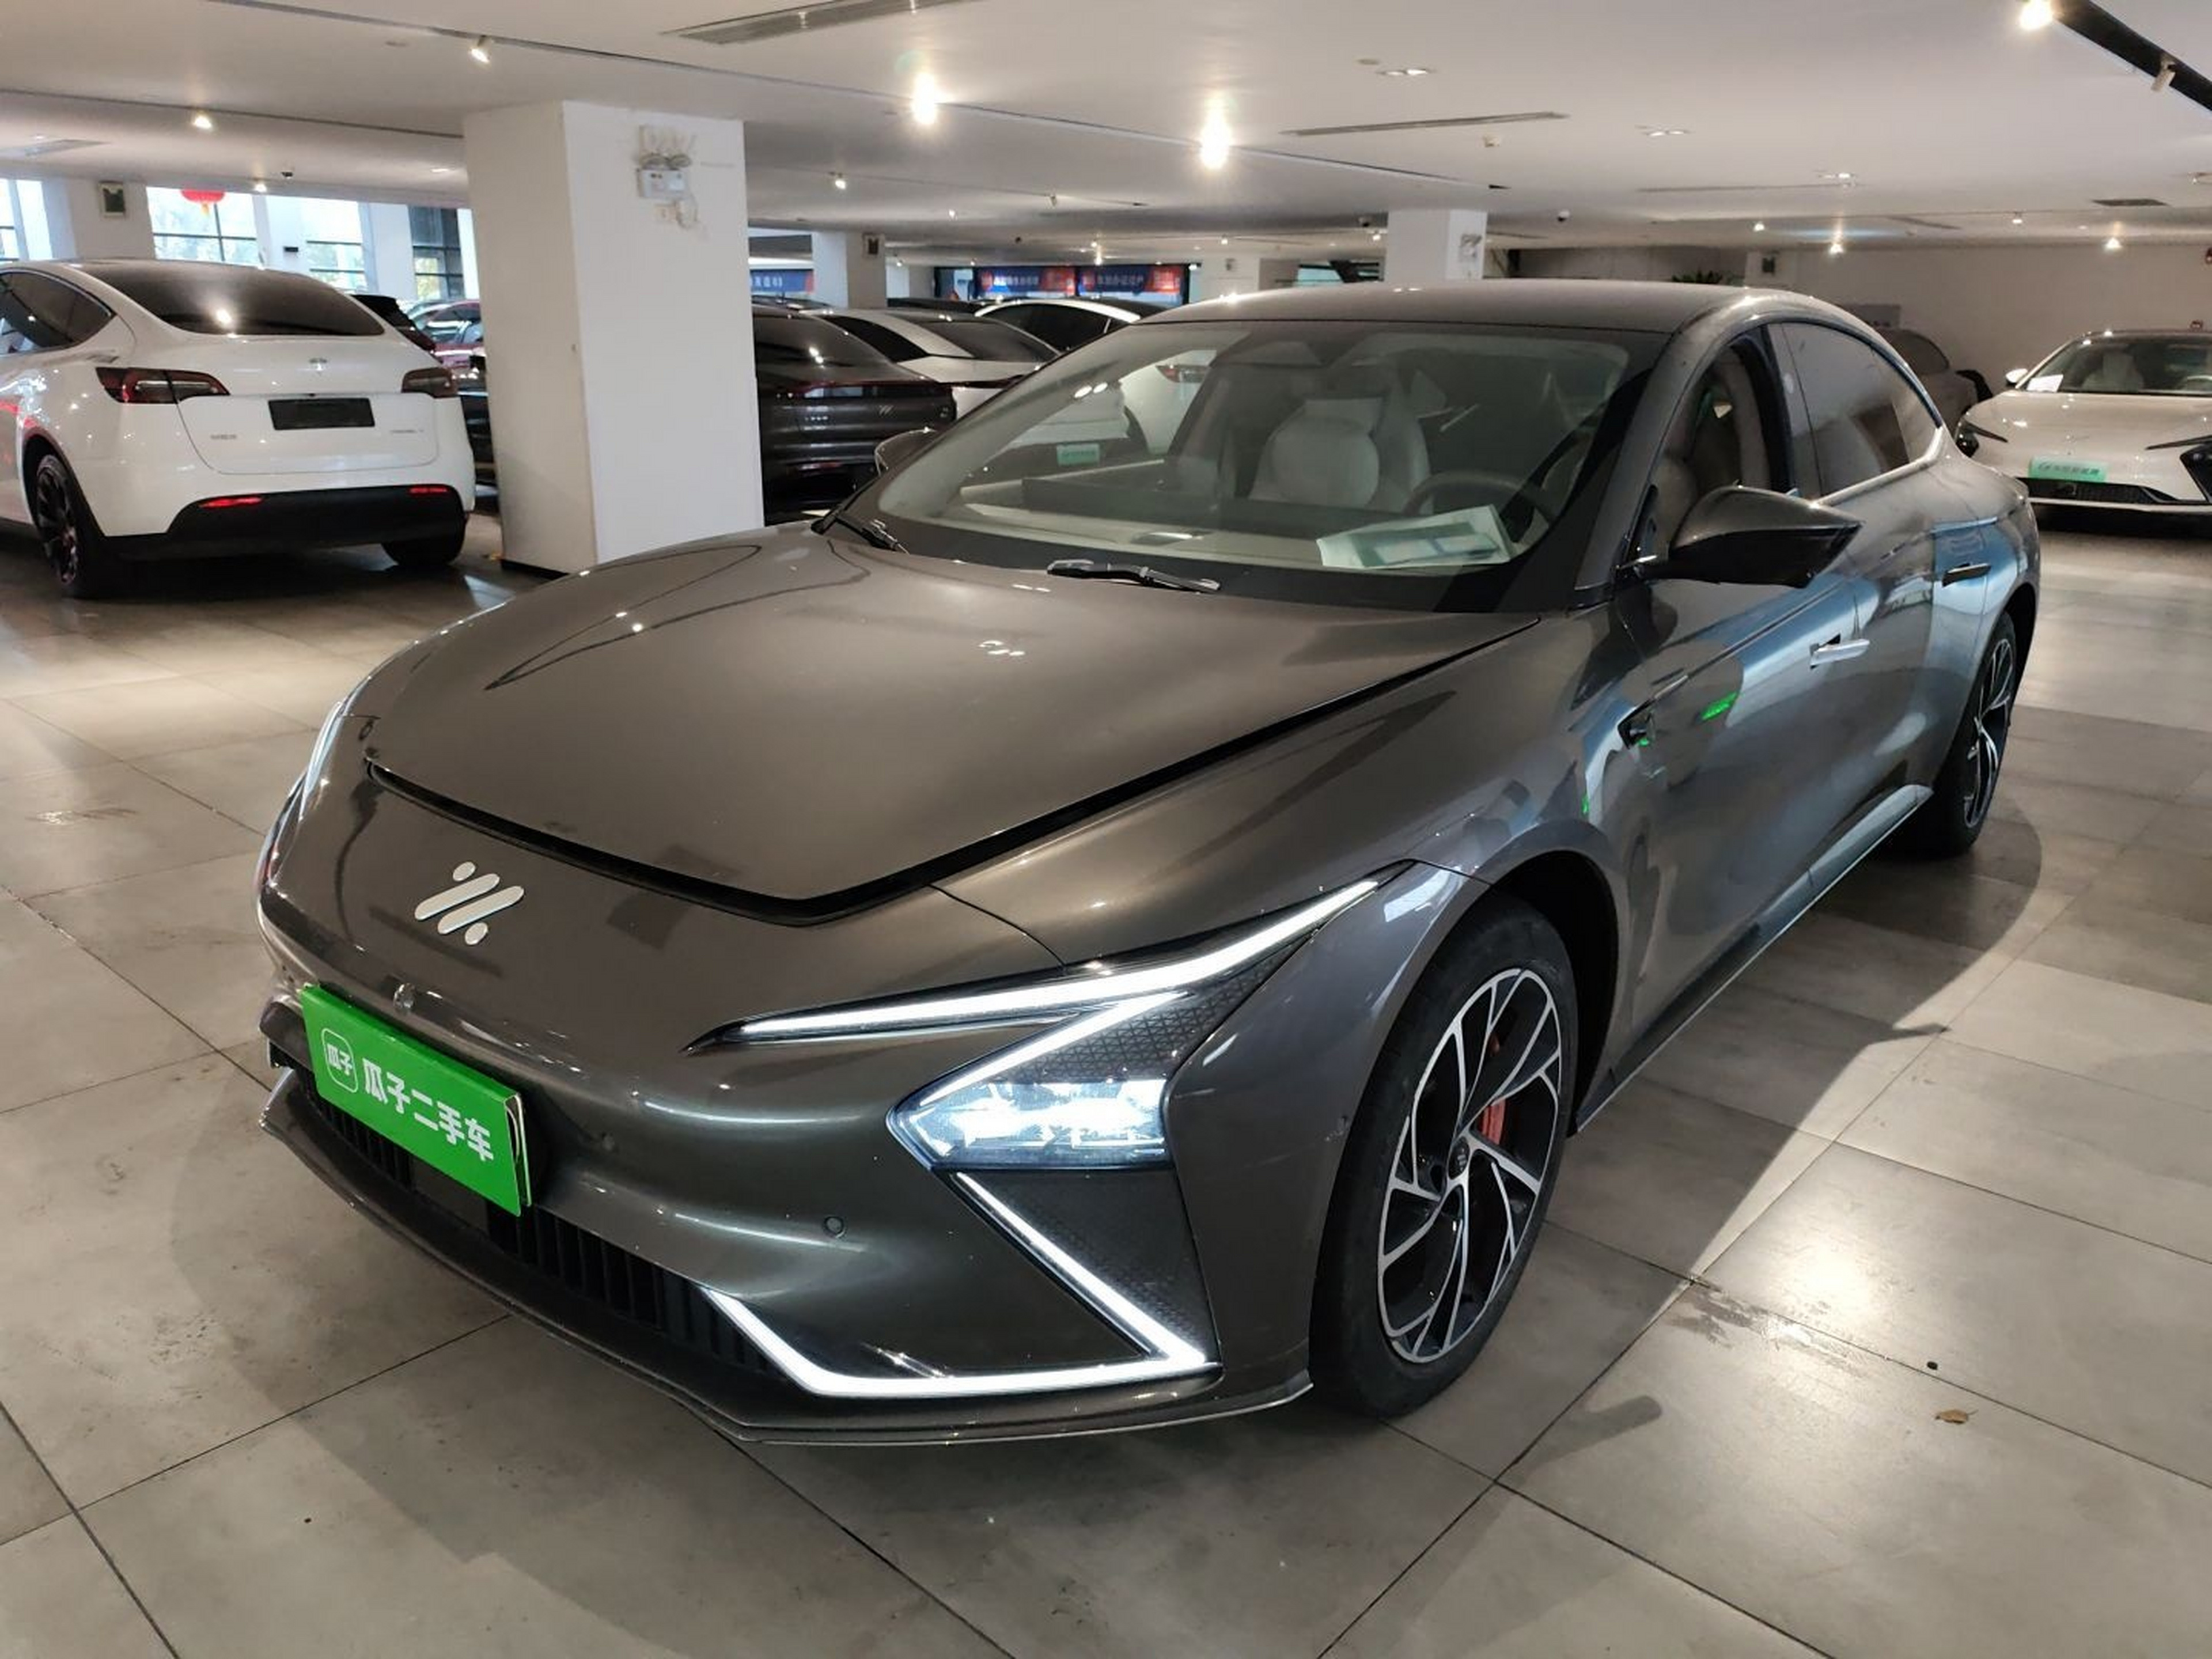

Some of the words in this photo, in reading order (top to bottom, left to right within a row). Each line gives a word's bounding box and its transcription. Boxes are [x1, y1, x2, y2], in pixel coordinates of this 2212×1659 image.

[327, 1044, 353, 1076] 瓜子
[362, 1058, 494, 1161] 瓜子二手车
